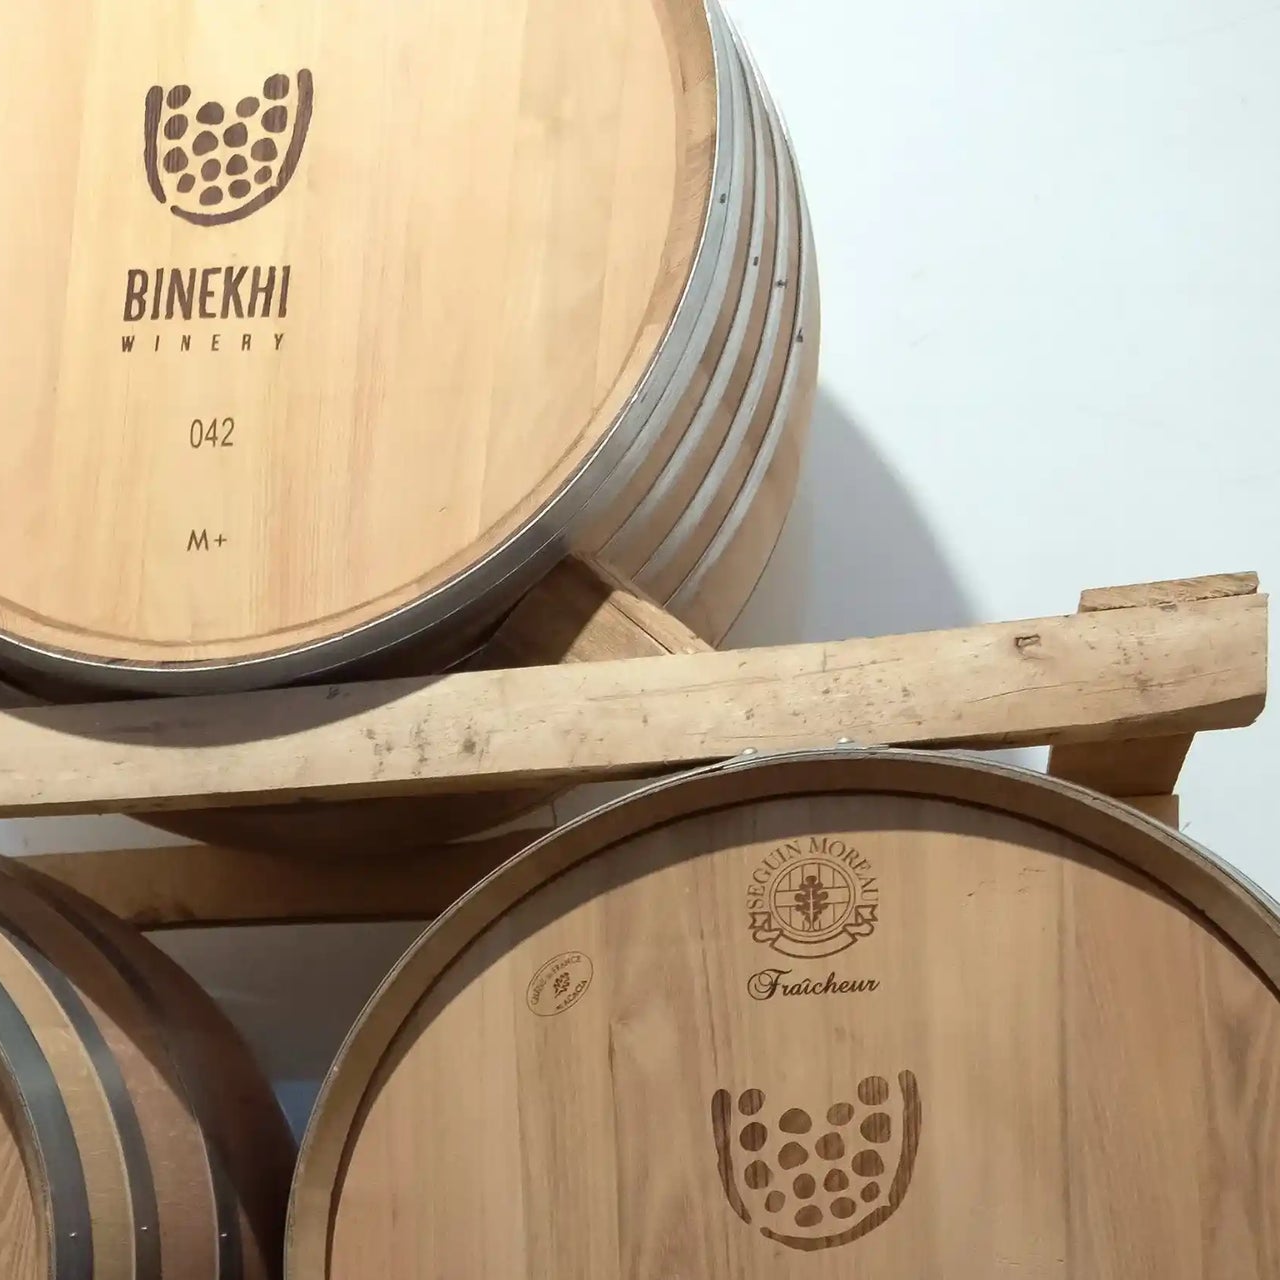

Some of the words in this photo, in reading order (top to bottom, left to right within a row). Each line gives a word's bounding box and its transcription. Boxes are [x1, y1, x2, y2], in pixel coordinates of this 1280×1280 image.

[123, 264, 292, 322] BINEKHI
[121, 333, 286, 353] WINERY
[189, 417, 235, 449] 042
[186, 529, 229, 552] M+
[746, 840, 802, 910] SEGUIN
[809, 837, 879, 902] MOREAU
[747, 968, 880, 1001] Fraîcheur
